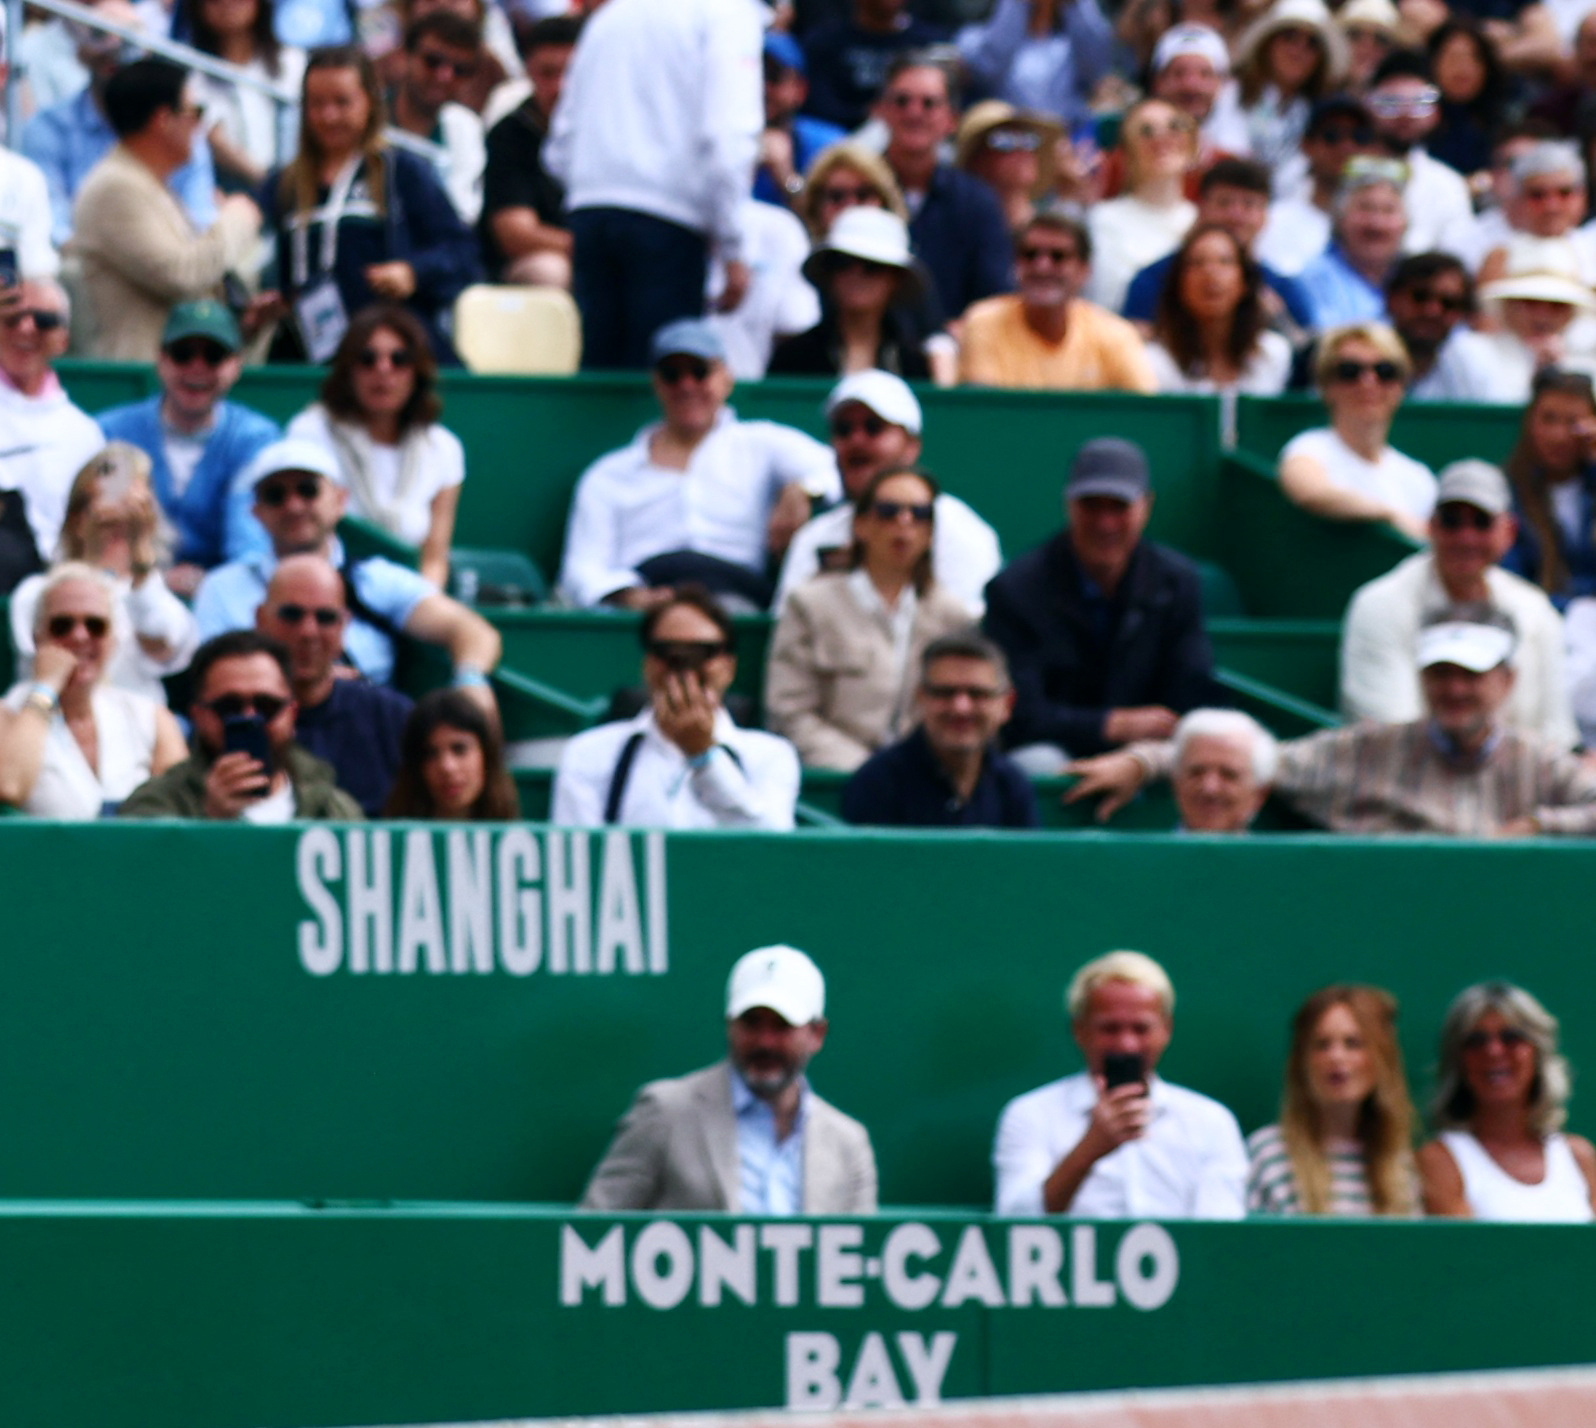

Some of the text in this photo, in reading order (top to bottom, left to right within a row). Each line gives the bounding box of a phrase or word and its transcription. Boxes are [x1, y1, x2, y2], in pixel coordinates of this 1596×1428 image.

[296, 826, 670, 977] SHANGHAI
[558, 1219, 1181, 1312] MONTE-CARLO
[785, 1331, 957, 1410] BAY
